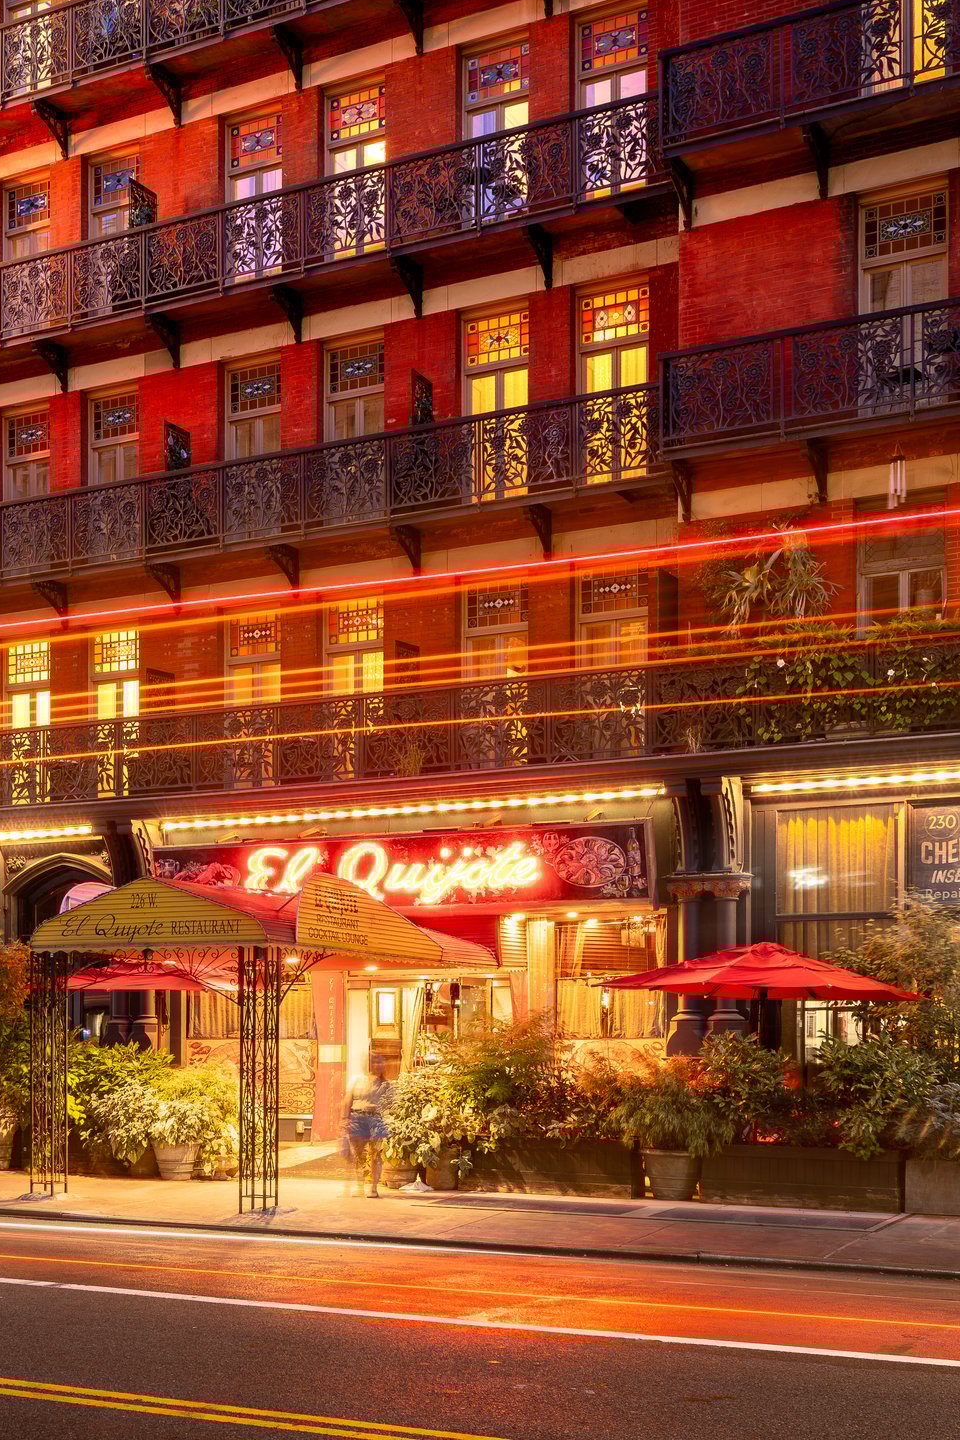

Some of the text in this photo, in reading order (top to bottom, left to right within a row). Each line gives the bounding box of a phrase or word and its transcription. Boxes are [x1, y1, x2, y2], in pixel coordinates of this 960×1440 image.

[928, 814, 957, 830] 230
[920, 838, 960, 865] CHE
[245, 841, 540, 904] El Quijote
[130, 893, 145, 909] 226
[61, 915, 91, 937] El
[171, 919, 242, 936] RESTAURANT
[316, 914, 360, 930] RESTAURANT
[308, 926, 369, 946] COCKTAIL LOUNGE
